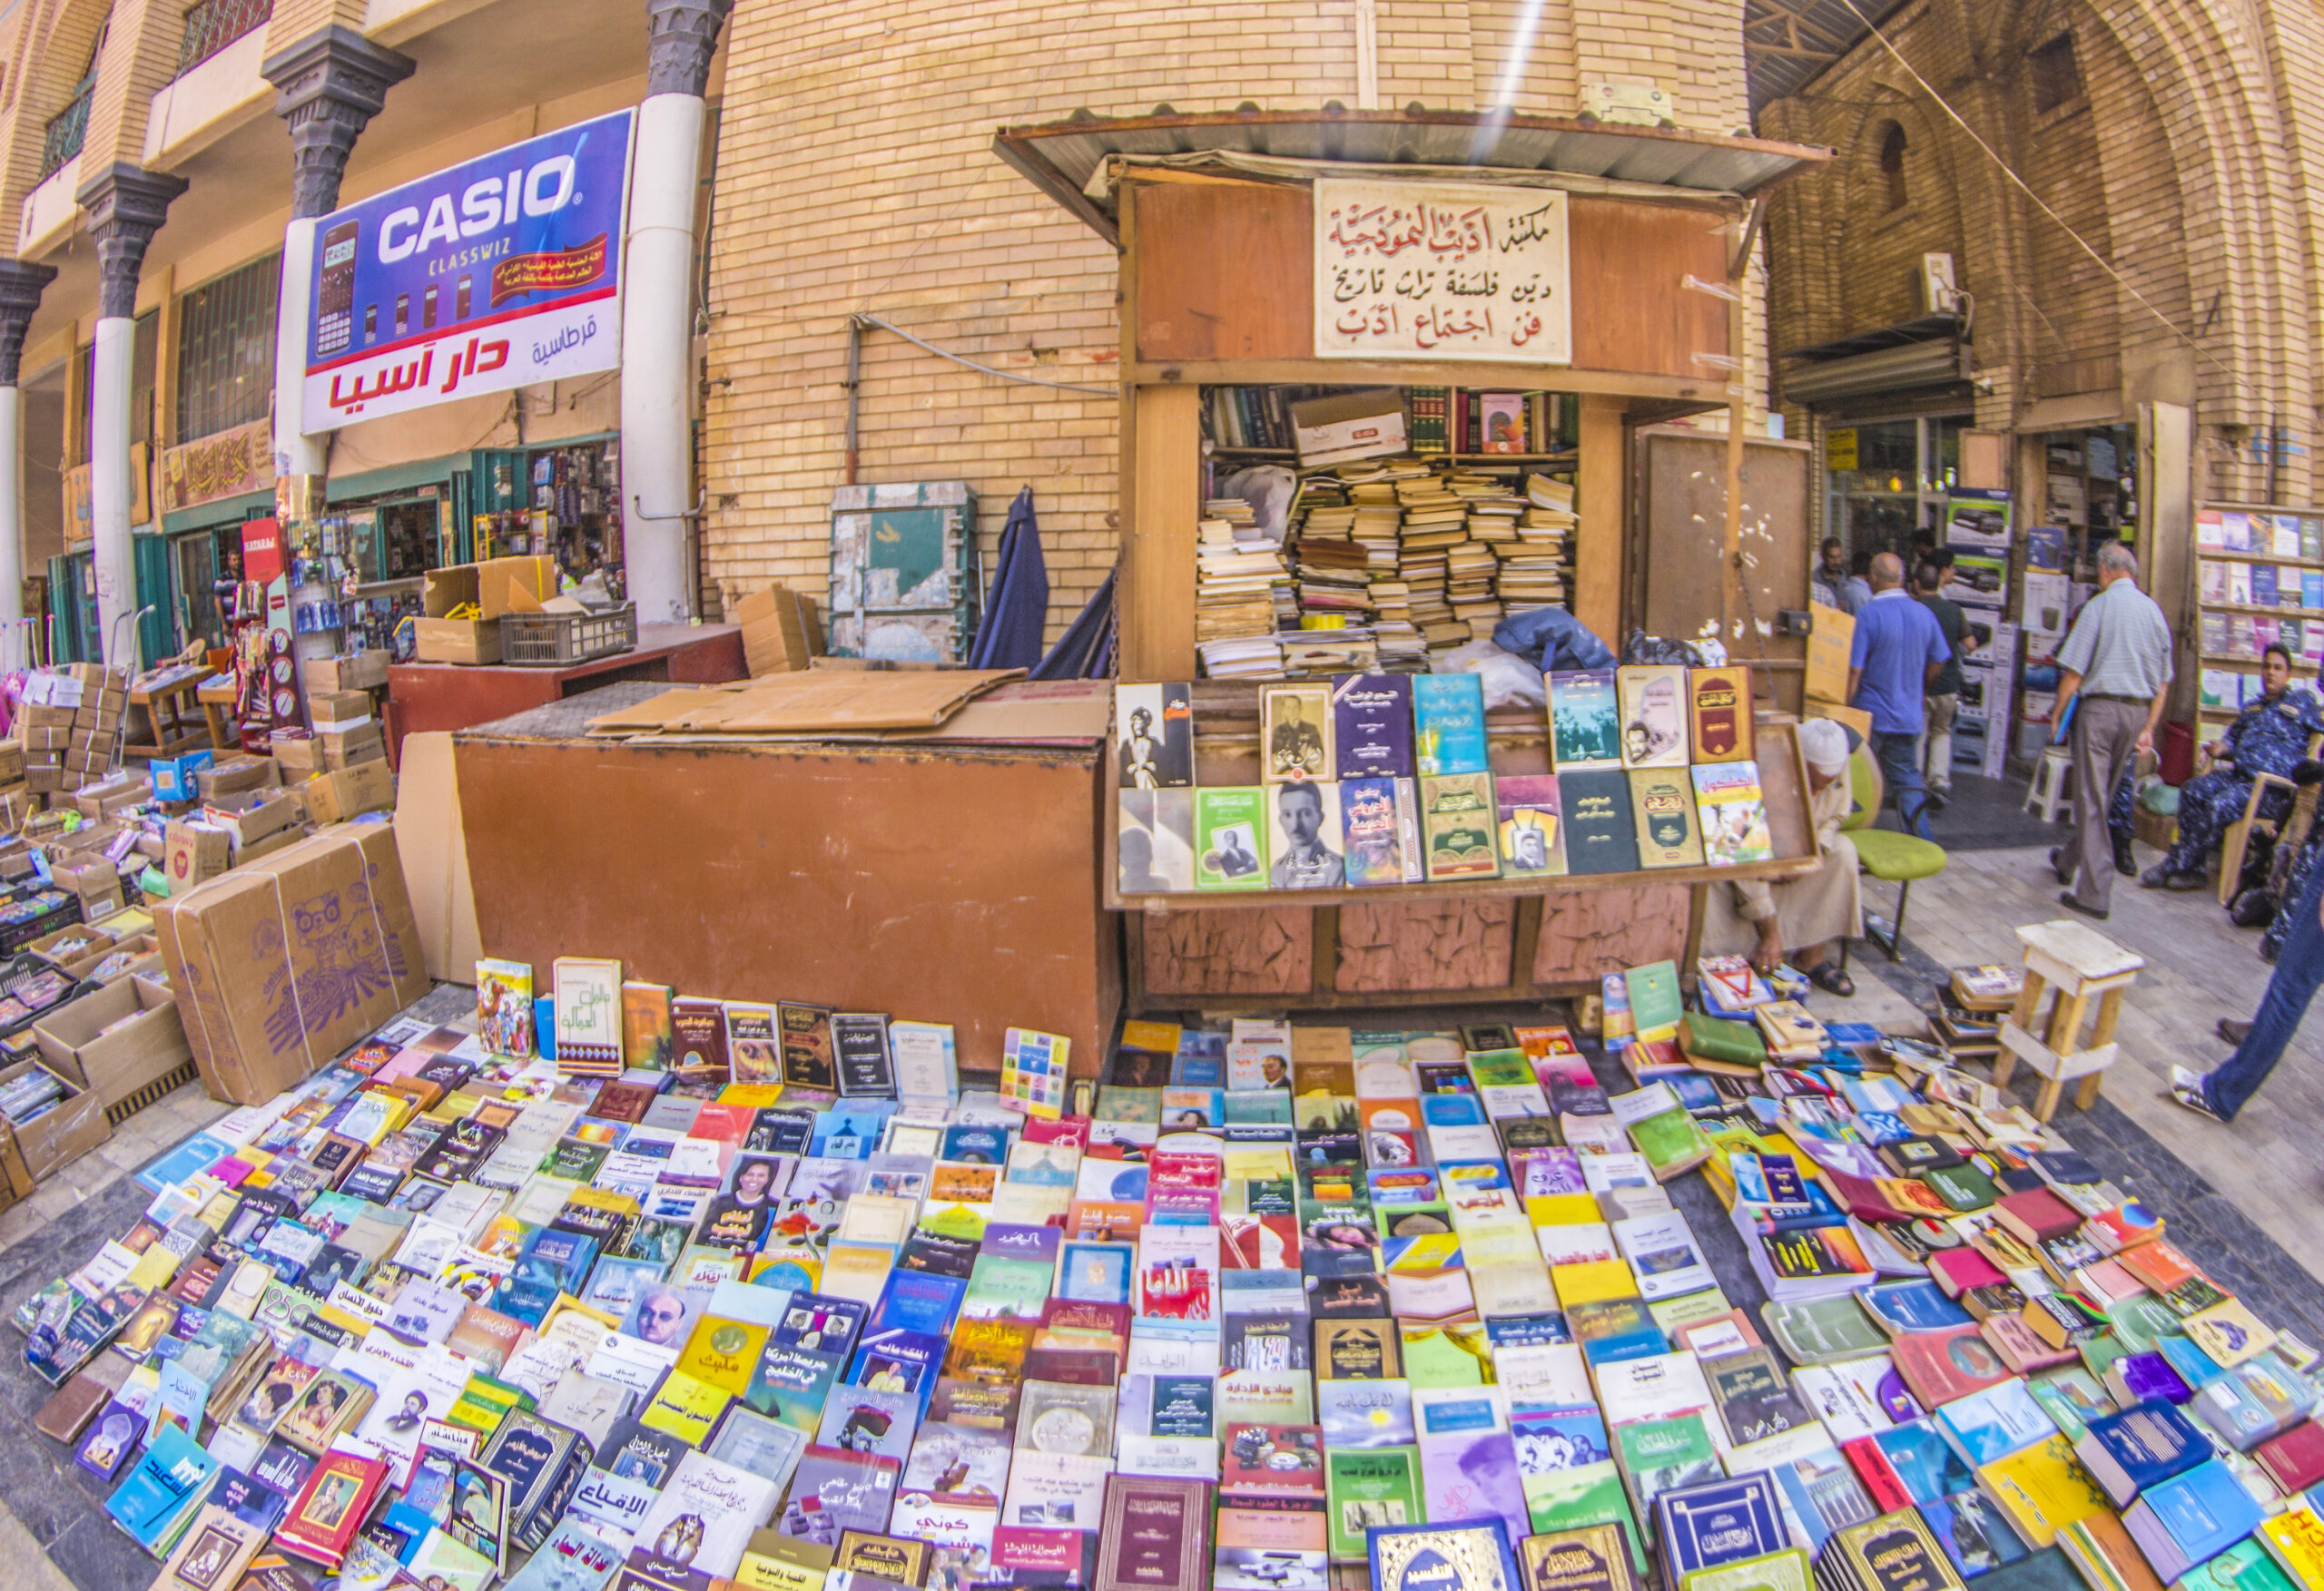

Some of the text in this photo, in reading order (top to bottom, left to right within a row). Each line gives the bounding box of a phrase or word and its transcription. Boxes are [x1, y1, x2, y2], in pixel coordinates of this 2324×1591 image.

[378, 153, 576, 264] CASIO
[1499, 201, 1554, 253] مكتبة
[428, 236, 511, 276] CLASSWIZ
[1332, 263, 1551, 303] دين فلسفة تراث تاريخ
[532, 314, 597, 366] قرطاسية
[1414, 303, 1493, 349] اجتماع
[1511, 309, 1542, 347] فن
[329, 337, 510, 415] دار آسيا
[363, 1301, 384, 1317] حقوق
[916, 1515, 969, 1531] كوني
